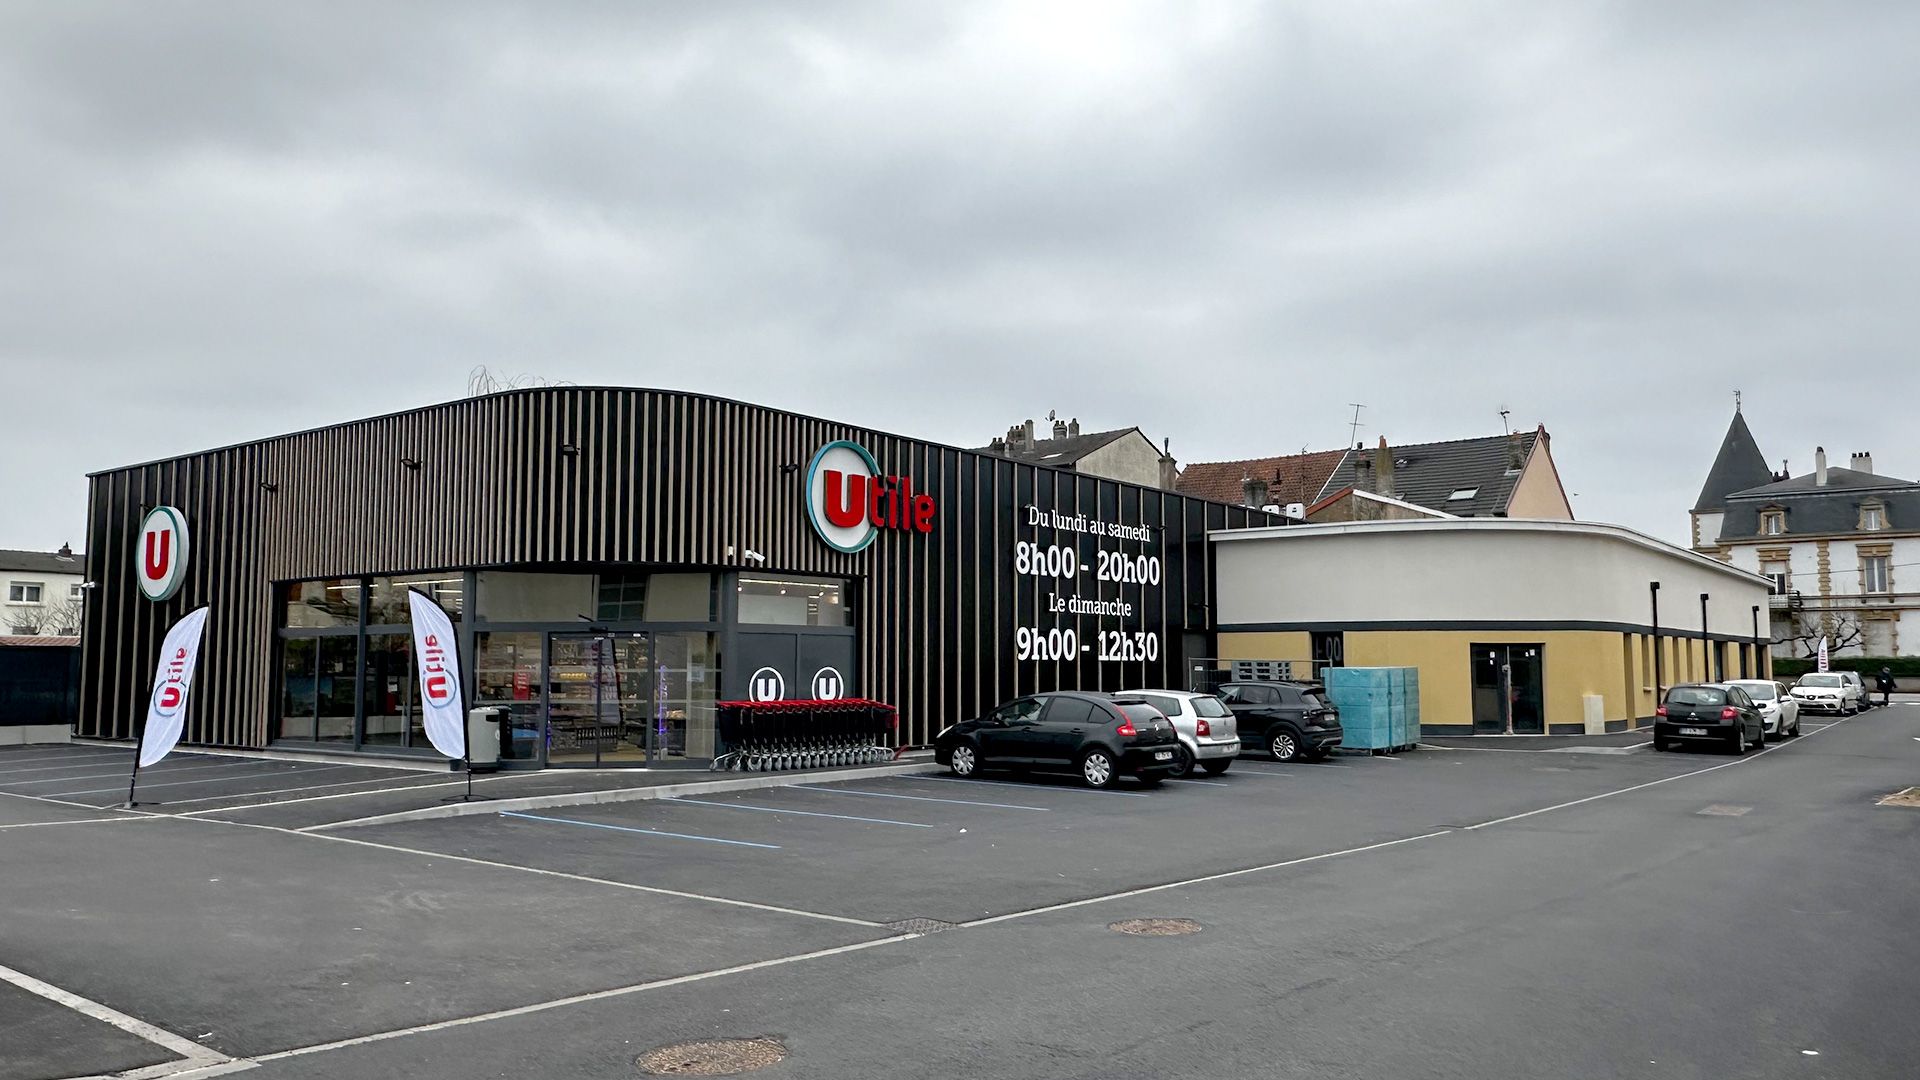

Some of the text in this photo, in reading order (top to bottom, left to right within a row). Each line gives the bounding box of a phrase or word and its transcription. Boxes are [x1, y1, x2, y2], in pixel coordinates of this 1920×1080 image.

[823, 469, 936, 533] Utile
[1028, 506, 1151, 543] Du lundi au samedi
[145, 529, 170, 580] U
[1016, 541, 1075, 579] 8h00
[1097, 550, 1160, 586] 20h00
[1049, 592, 1132, 617] Le dimanche
[1016, 627, 1077, 662] 9h00
[1098, 630, 1158, 662] 12h30
[160, 647, 187, 707] Utile
[757, 678, 777, 702] U
[819, 677, 837, 701] U
